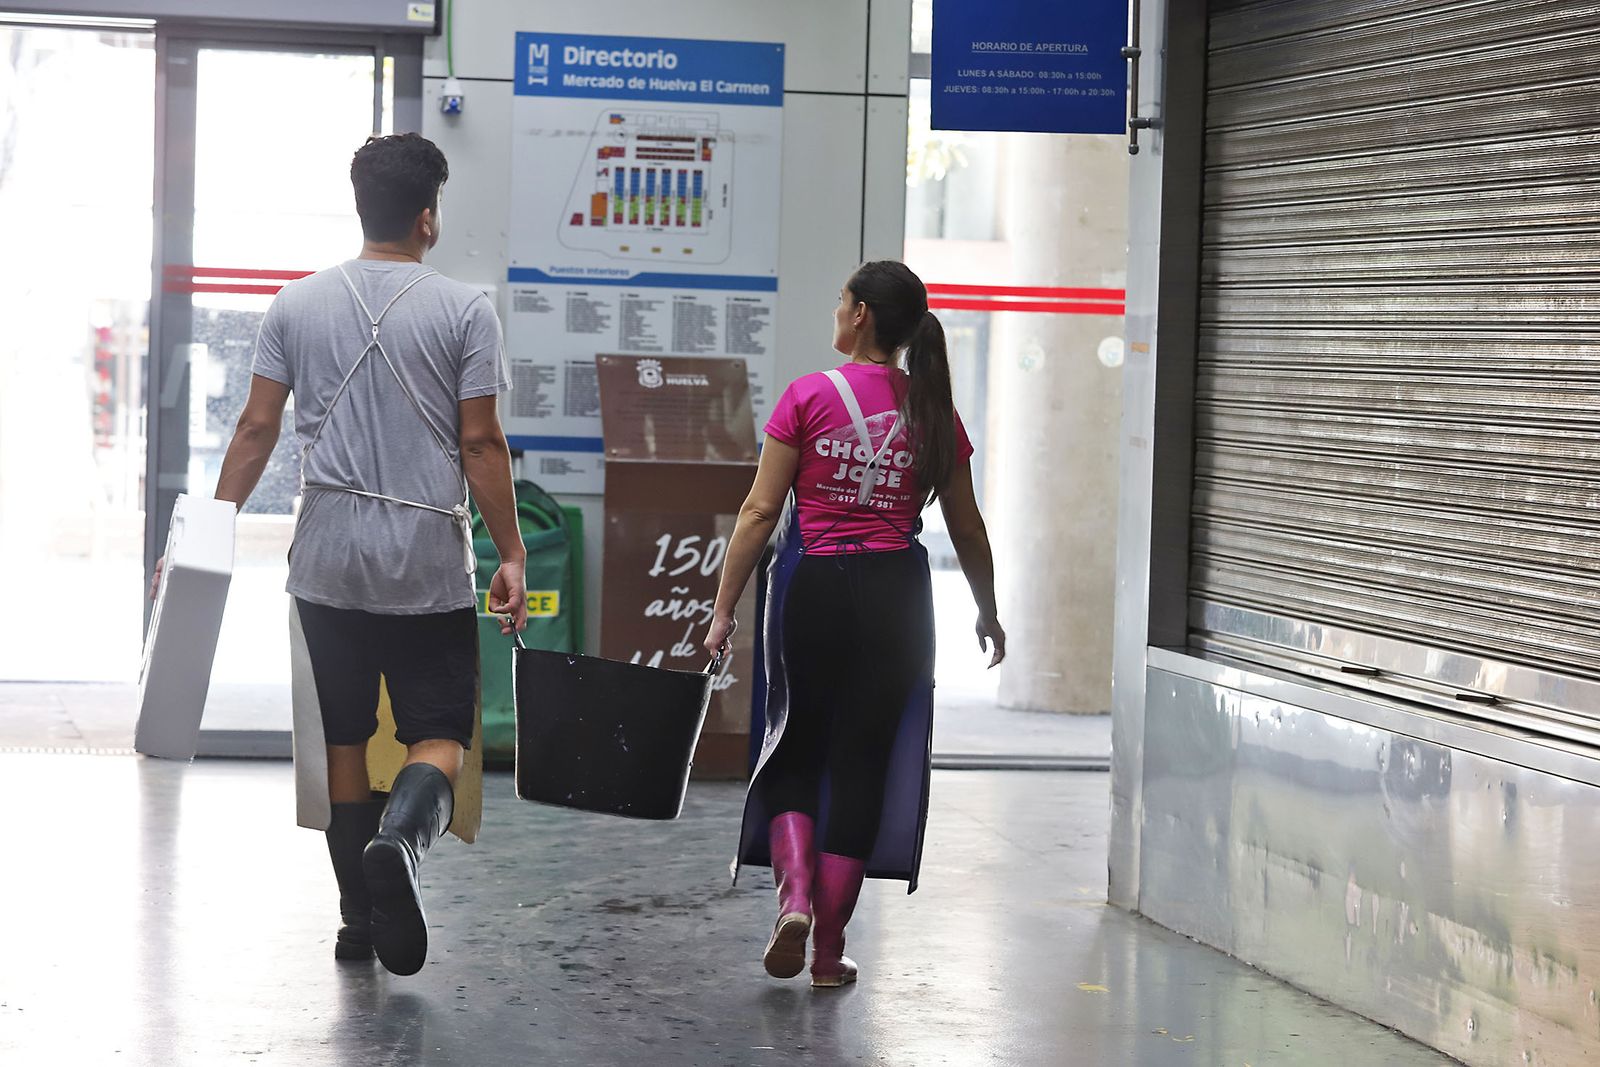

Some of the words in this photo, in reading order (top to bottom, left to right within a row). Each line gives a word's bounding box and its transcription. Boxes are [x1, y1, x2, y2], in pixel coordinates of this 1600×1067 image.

[563, 46, 678, 70] Directorio
[971, 42, 1017, 51] HORARIO
[1020, 43, 1033, 51] DE
[1035, 43, 1088, 52] APERTURA
[562, 73, 624, 88] Mercado
[627, 77, 646, 89] de
[650, 78, 697, 92] Huelva
[700, 80, 713, 92] El
[716, 81, 770, 95] Carmen
[958, 69, 987, 77] LUNES
[1038, 71, 1066, 79] 08:30h
[1075, 72, 1101, 80] 15:00h
[982, 86, 1009, 94] 08:30h
[1019, 87, 1045, 95] 15:00h
[1088, 88, 1115, 96] 20:30h
[549, 266, 585, 275] Puestos
[666, 377, 709, 386] HUELVA
[815, 438, 913, 468] CHOCO
[832, 463, 902, 488] JOSE
[838, 495, 855, 503] 617
[877, 500, 893, 508] 581
[648, 533, 727, 577] 150
[644, 586, 715, 625] años
[670, 622, 696, 657] de
